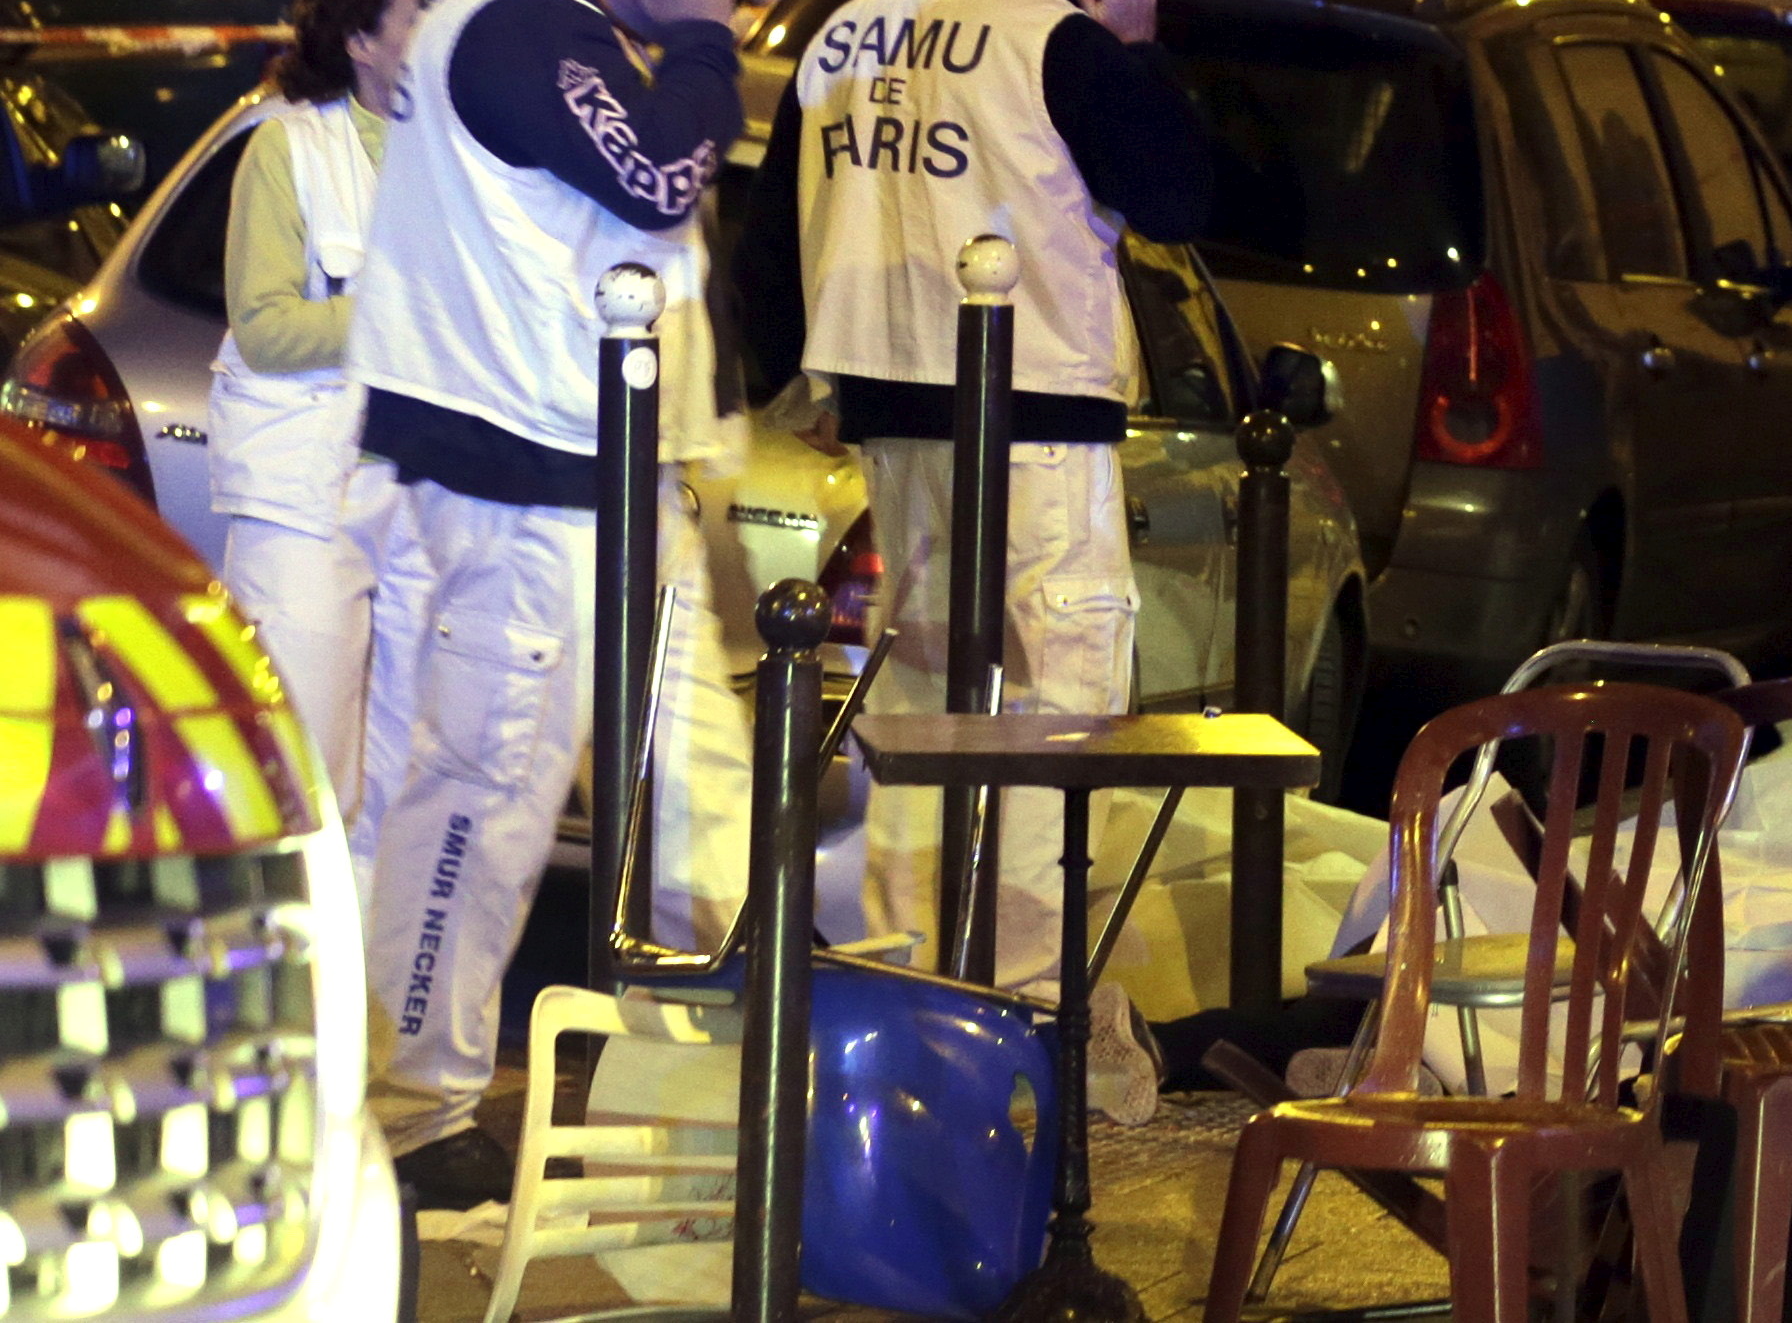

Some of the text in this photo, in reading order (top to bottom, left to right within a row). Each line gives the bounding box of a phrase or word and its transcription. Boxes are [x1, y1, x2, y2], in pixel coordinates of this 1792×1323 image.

[817, 15, 991, 75] SAMU
[821, 112, 970, 179] PARIS
[397, 811, 472, 1038] SMUR NECKER
